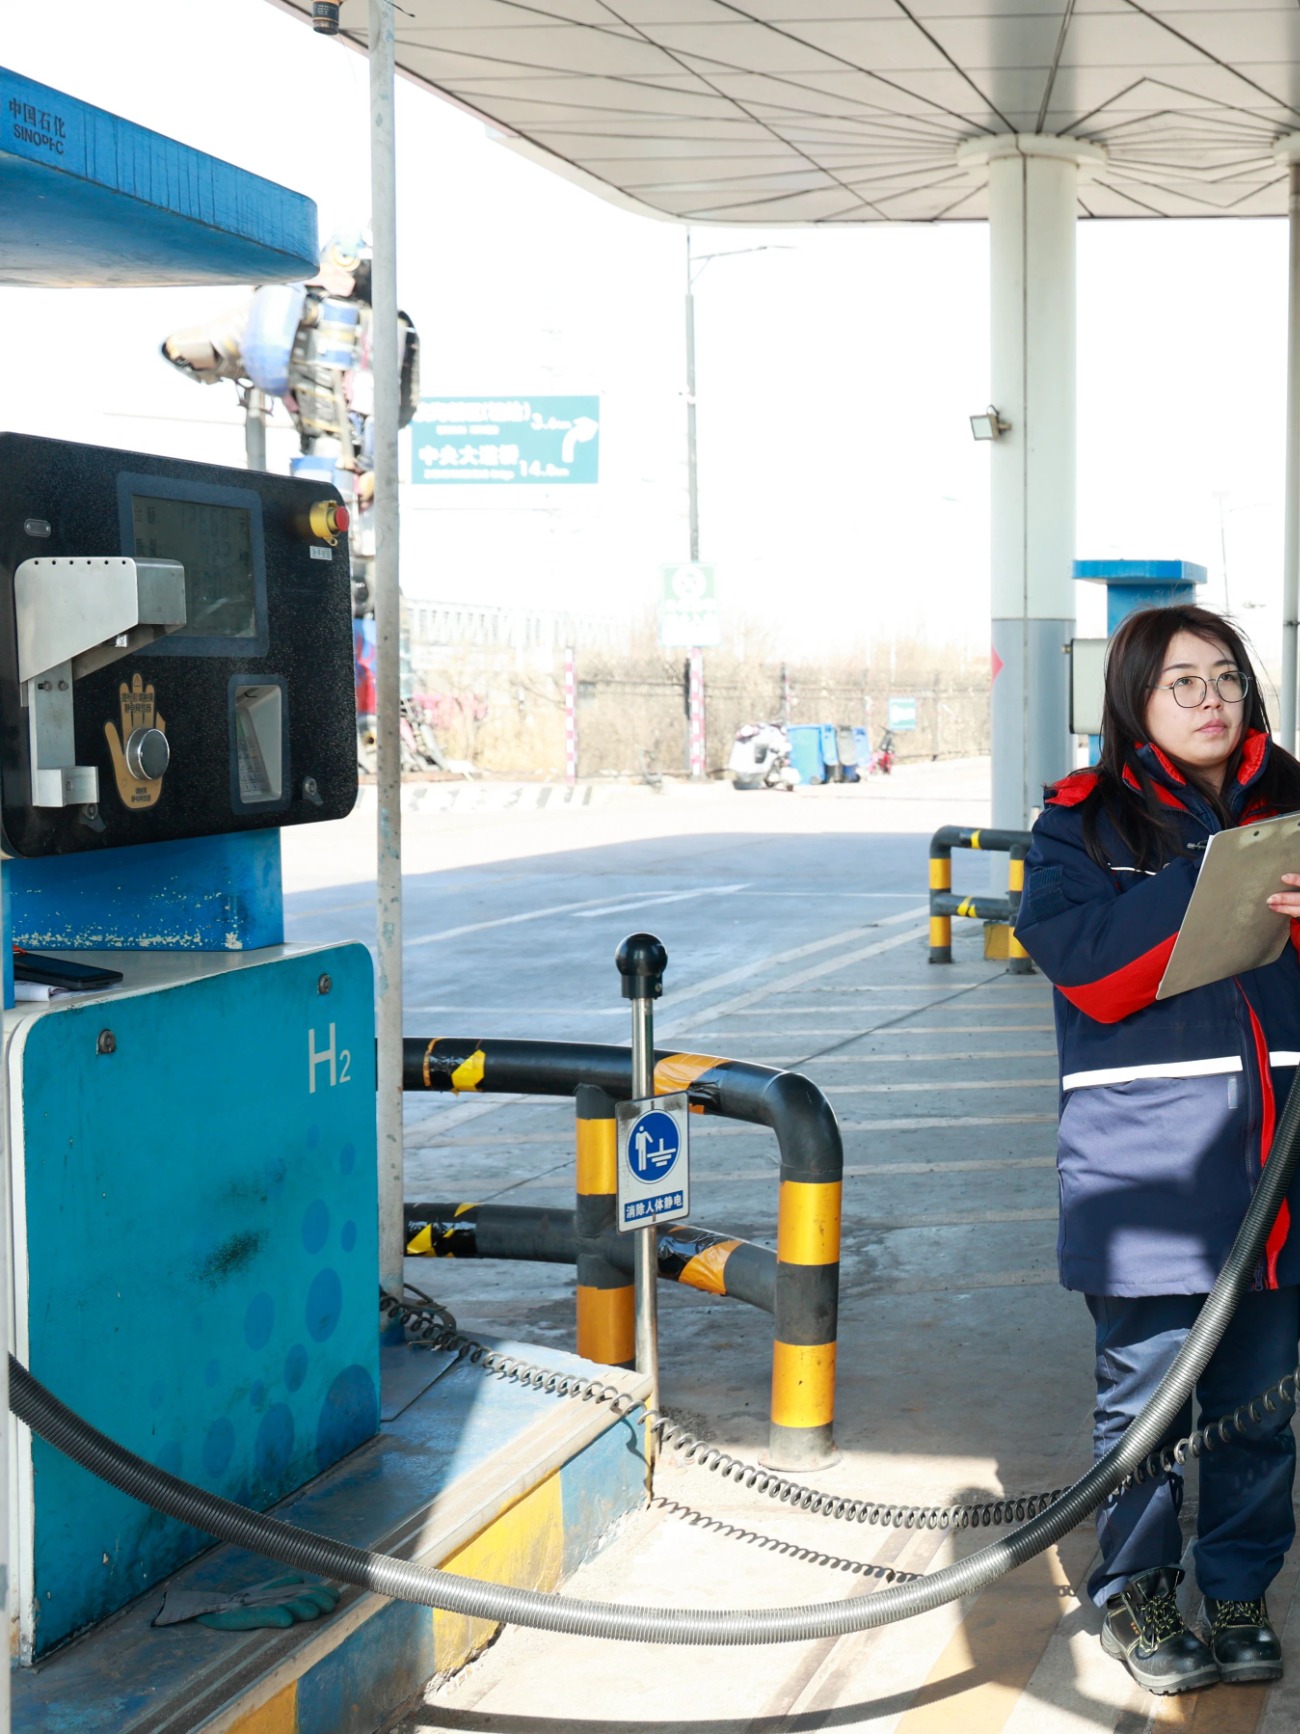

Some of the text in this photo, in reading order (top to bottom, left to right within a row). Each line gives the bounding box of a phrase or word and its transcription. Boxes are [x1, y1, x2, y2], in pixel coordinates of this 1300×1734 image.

[9, 97, 66, 139] 中国石化
[13, 123, 65, 155] SINOPEC
[308, 1022, 351, 1095] H2
[626, 1193, 683, 1219] 消除人体静电
